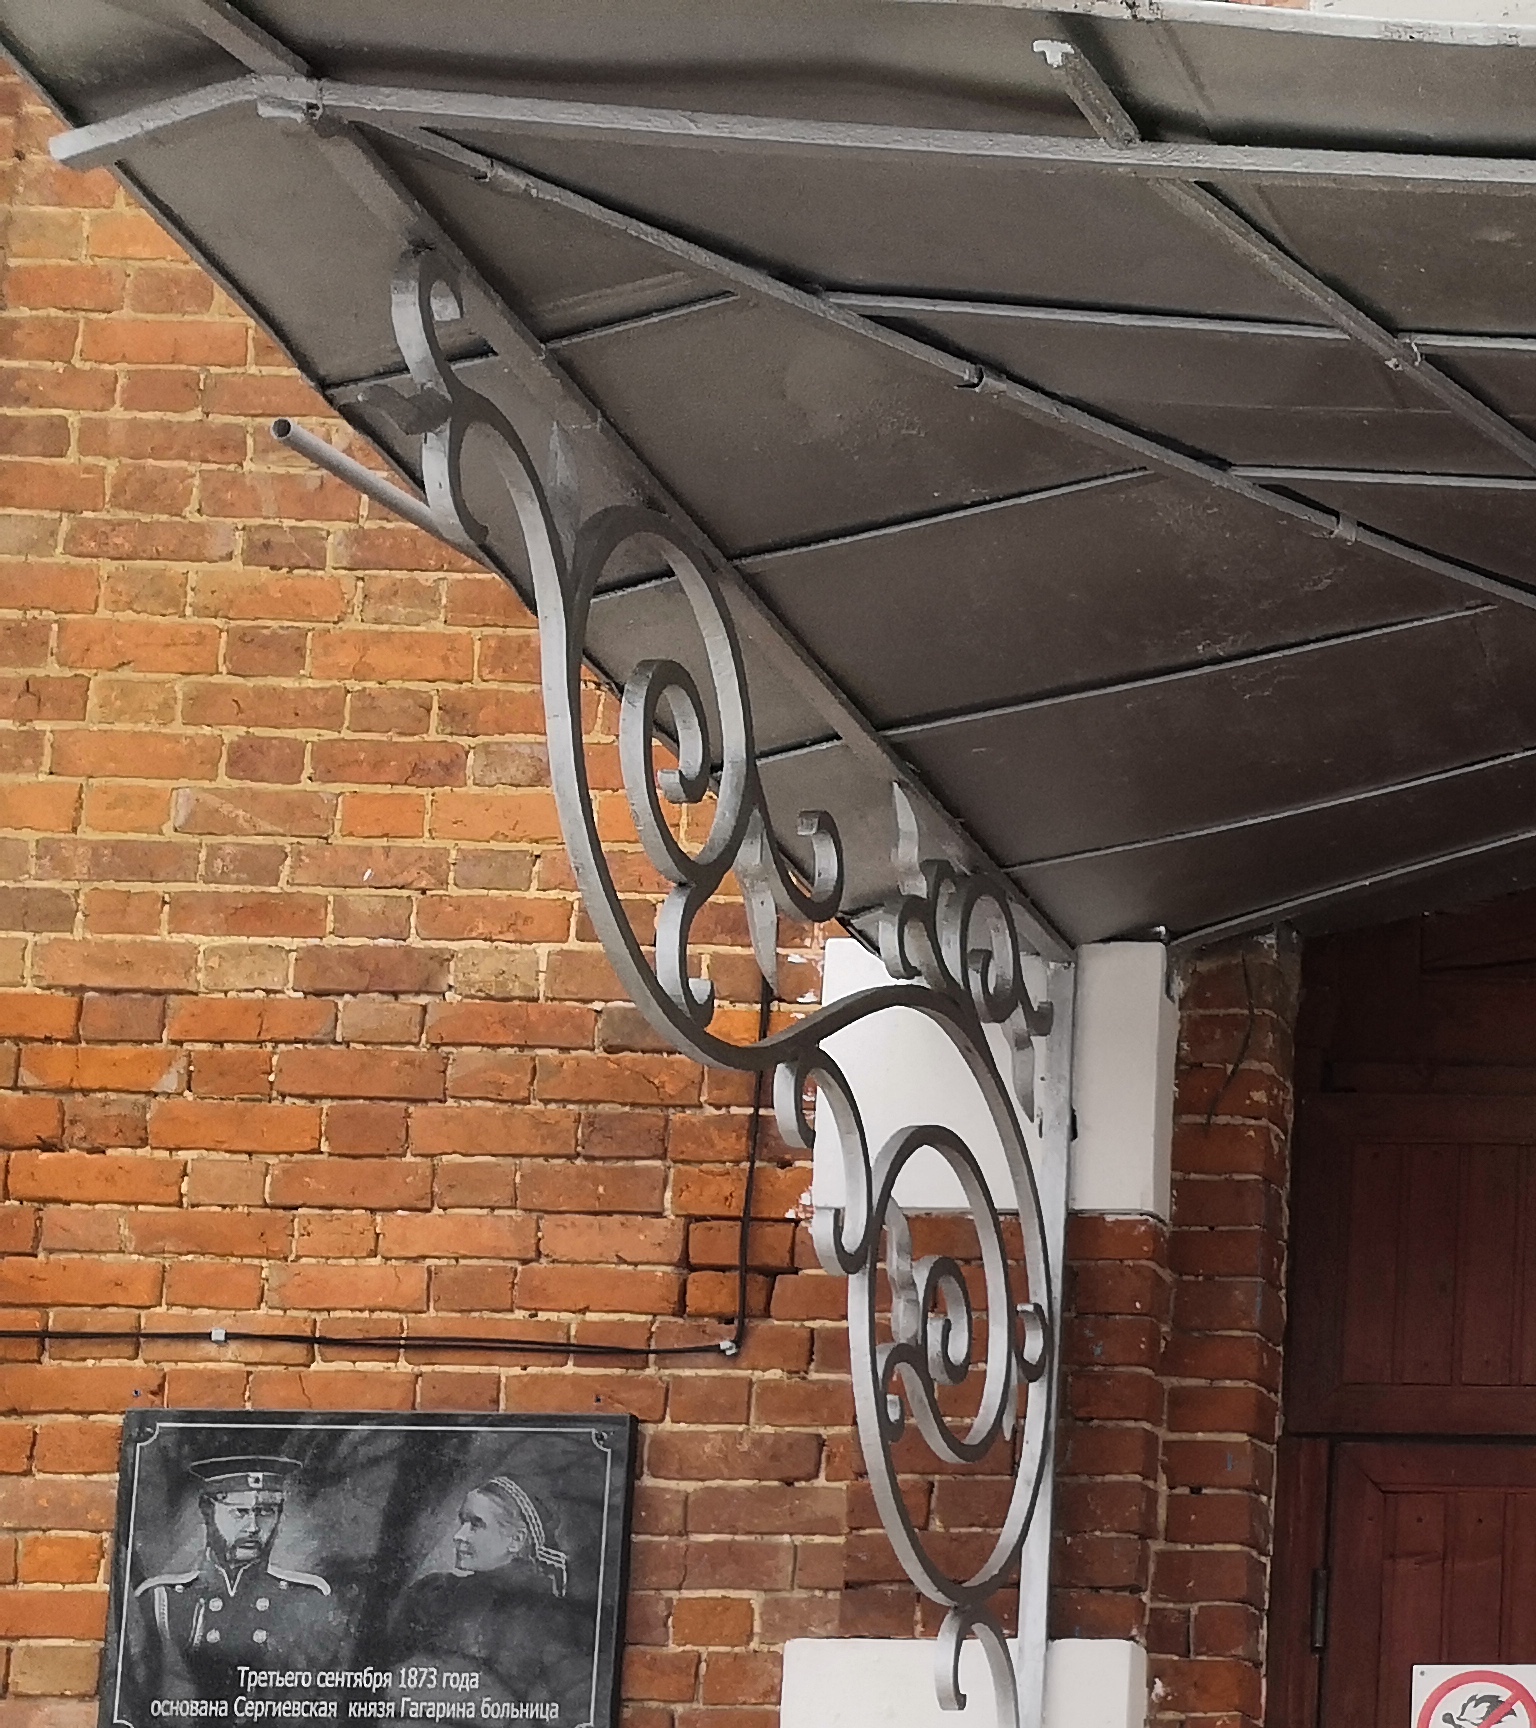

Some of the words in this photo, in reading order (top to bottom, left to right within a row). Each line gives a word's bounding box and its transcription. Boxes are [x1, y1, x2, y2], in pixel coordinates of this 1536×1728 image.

[237, 1666, 312, 1692] Третьего
[316, 1666, 392, 1693] сентября
[399, 1667, 437, 1689] 1873
[442, 1672, 479, 1692] года
[150, 1700, 228, 1717] основана
[233, 1696, 337, 1722] Сергиевская
[348, 1701, 395, 1718] князя
[400, 1697, 475, 1722] Гагарина
[480, 1697, 559, 1722] больница
